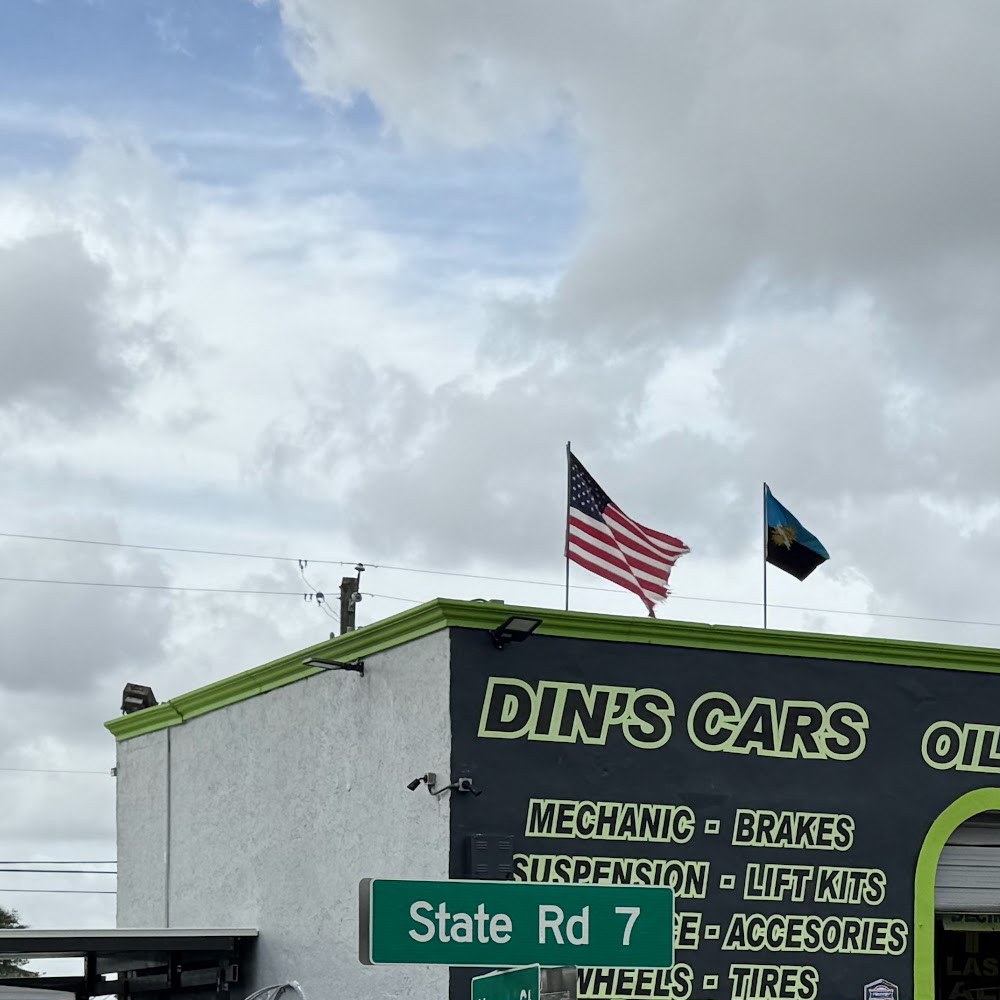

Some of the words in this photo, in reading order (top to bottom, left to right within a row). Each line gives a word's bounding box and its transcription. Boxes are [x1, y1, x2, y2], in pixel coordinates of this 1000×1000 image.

[478, 677, 675, 748] DIN'S
[687, 692, 869, 760] CARS
[525, 799, 695, 844] MECHANIC
[732, 809, 855, 850] BRAKES
[744, 864, 813, 902] LIFT
[815, 866, 886, 906] KITS
[408, 901, 512, 942] State
[538, 905, 589, 945] Rd
[615, 907, 640, 946] 7
[722, 914, 908, 955] ACCESORIES
[577, 963, 694, 1000] WHEELS
